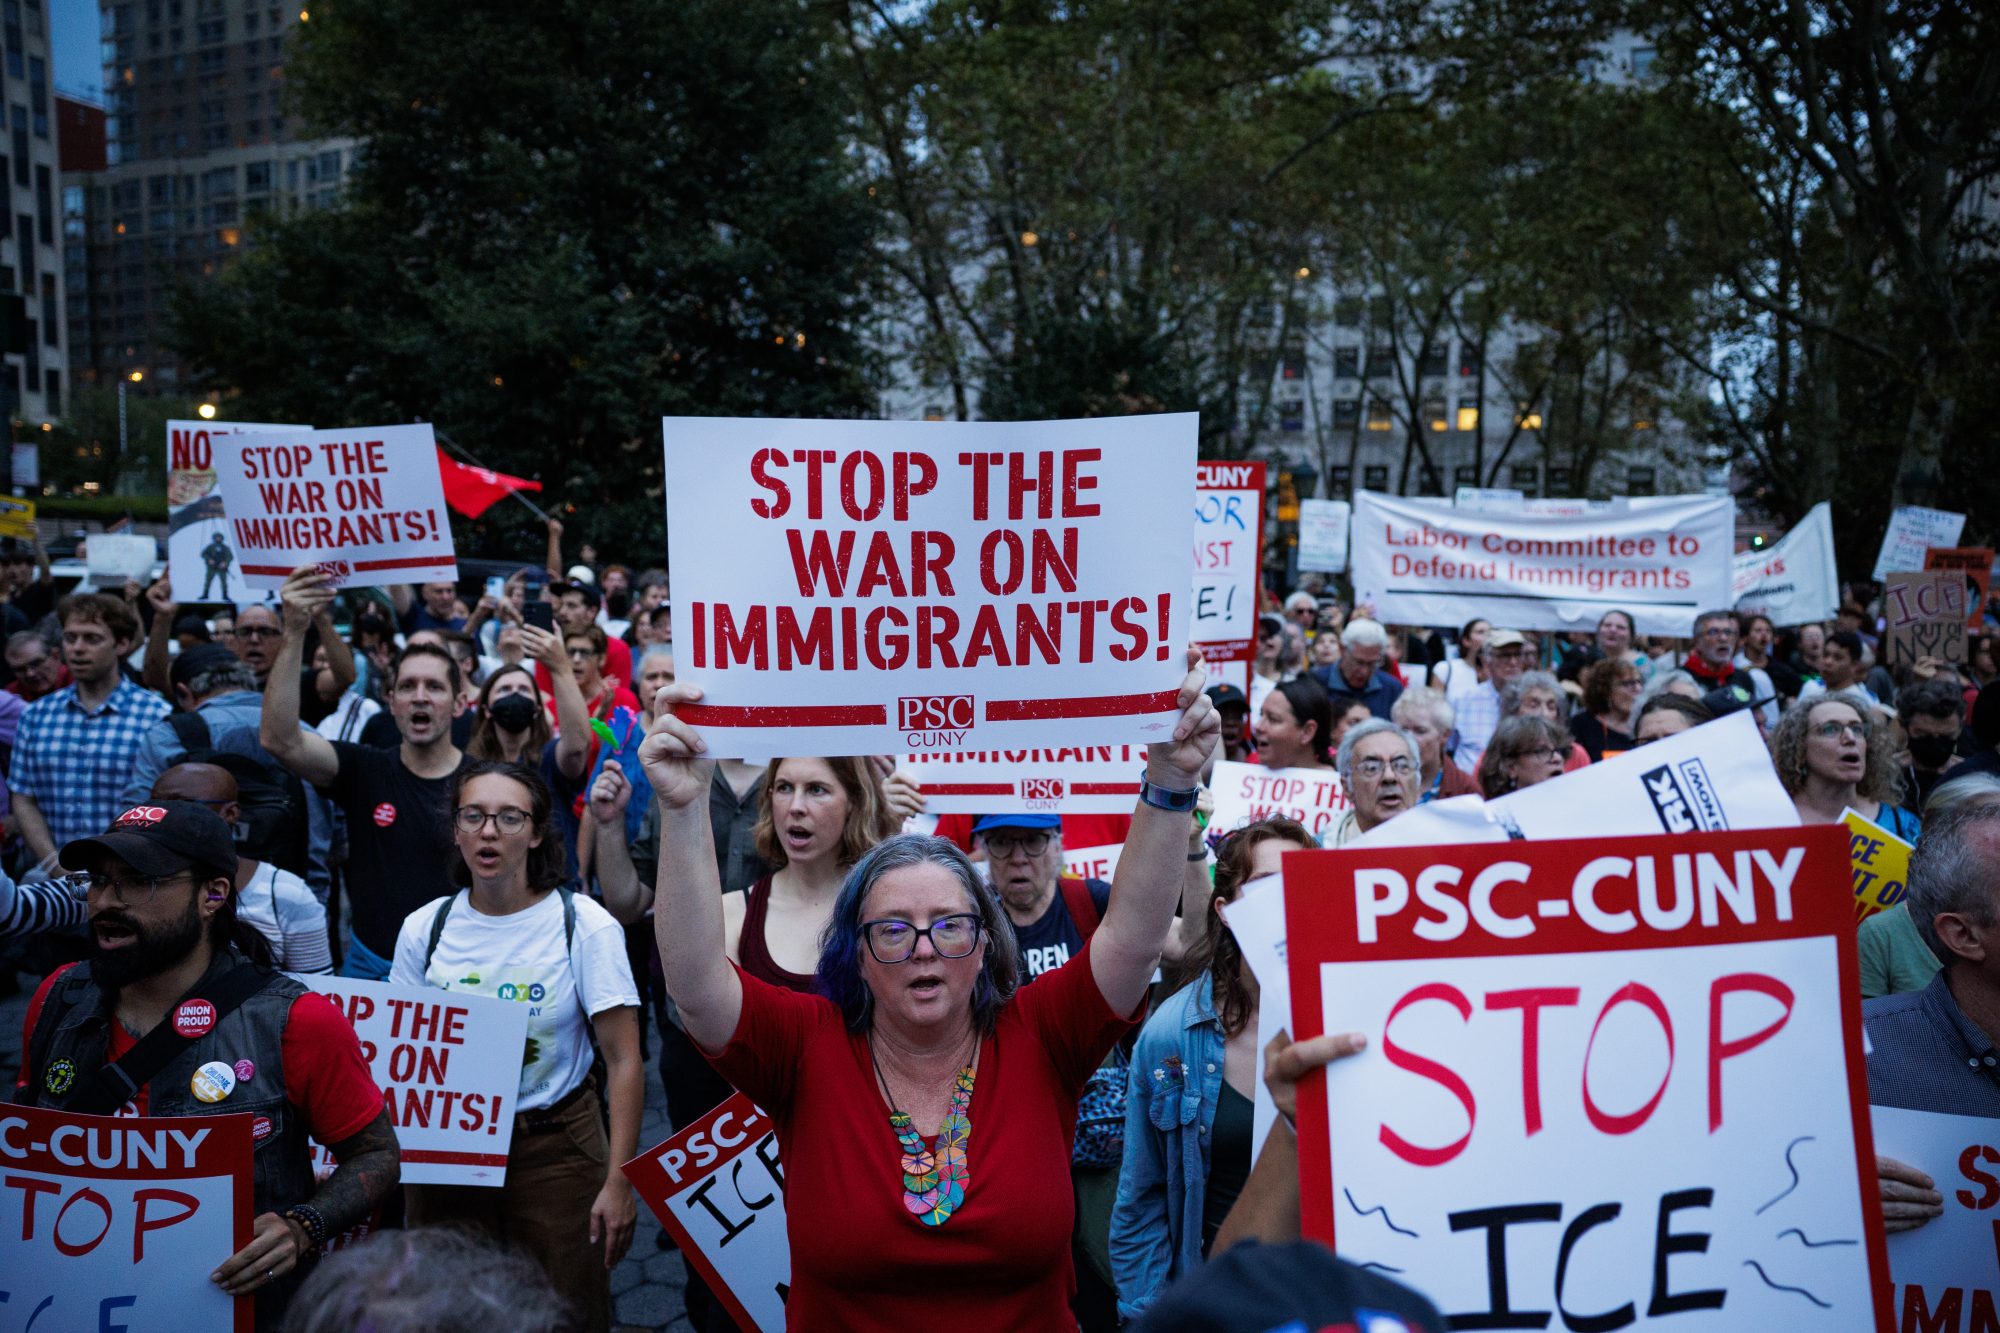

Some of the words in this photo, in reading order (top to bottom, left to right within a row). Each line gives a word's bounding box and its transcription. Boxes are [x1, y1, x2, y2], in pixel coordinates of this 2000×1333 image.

[172, 430, 229, 471] NO
[241, 445, 312, 479] STOP
[320, 441, 387, 476] THE
[258, 481, 327, 515] WAR
[335, 478, 383, 512] ON
[750, 447, 938, 522] STOP
[958, 448, 1102, 521] THE
[234, 509, 440, 549] IMMIGRANTS!
[1386, 524, 1469, 550] Labor
[1482, 533, 1655, 558] Committee
[1667, 533, 1698, 557] to
[785, 529, 956, 598] WAR
[979, 527, 1079, 595] ON
[1392, 554, 1496, 581] Defend
[1508, 562, 1691, 592] Immigrants
[1887, 583, 1963, 626] ICE
[692, 592, 1171, 671] IMMIGRANTS!
[1912, 622, 1942, 638] OUT
[1894, 636, 1962, 663] NYC
[899, 696, 974, 730] PSC
[907, 730, 967, 747] CUNY
[1022, 779, 1063, 799] PSC
[1025, 800, 1060, 810] CUNY
[1240, 775, 1305, 803] STOP
[116, 806, 168, 822] PSC
[1354, 847, 1806, 944] PSC-CUNY
[179, 1005, 211, 1016] UNION
[501, 986, 543, 1000] NYC
[177, 1016, 211, 1027] PROUD
[387, 999, 469, 1045] THE
[389, 1044, 449, 1086] ON
[1378, 972, 1796, 1167] STOP
[1446, 1187, 1728, 1333] ICE
